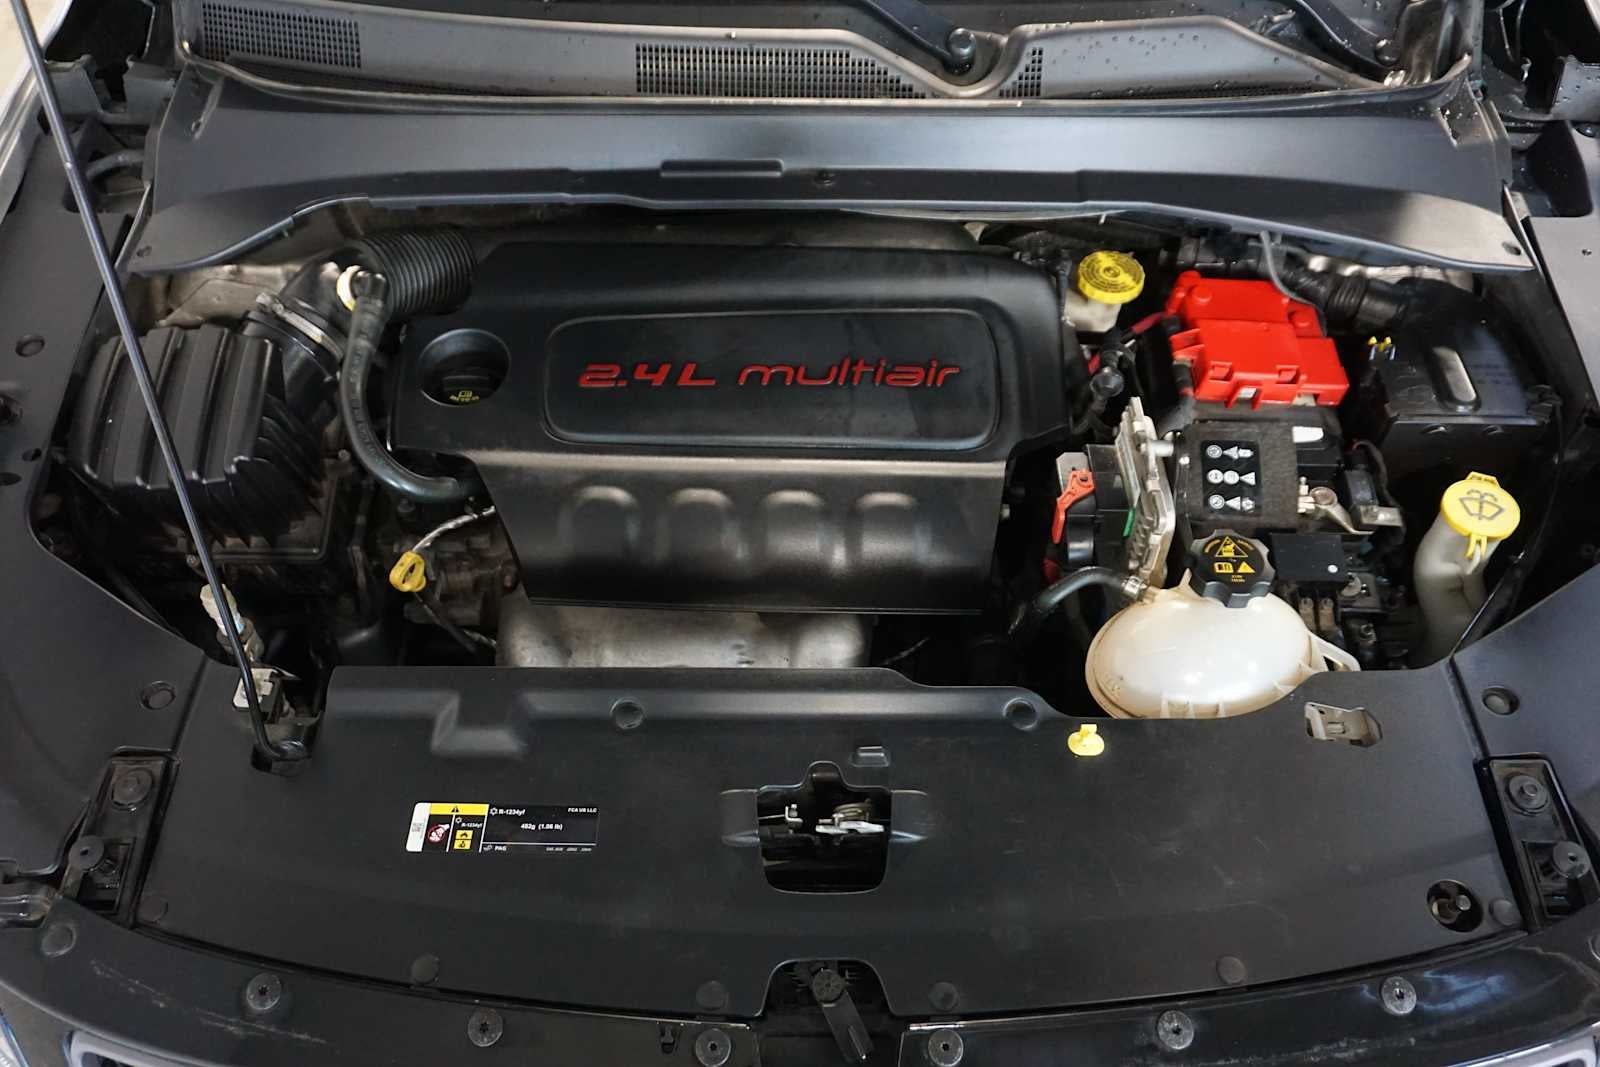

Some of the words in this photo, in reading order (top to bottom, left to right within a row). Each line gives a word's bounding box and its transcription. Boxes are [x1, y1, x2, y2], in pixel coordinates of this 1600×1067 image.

[578, 362, 716, 388] 2.4L
[737, 356, 961, 388] multiair
[498, 808, 526, 817] R-1234yf
